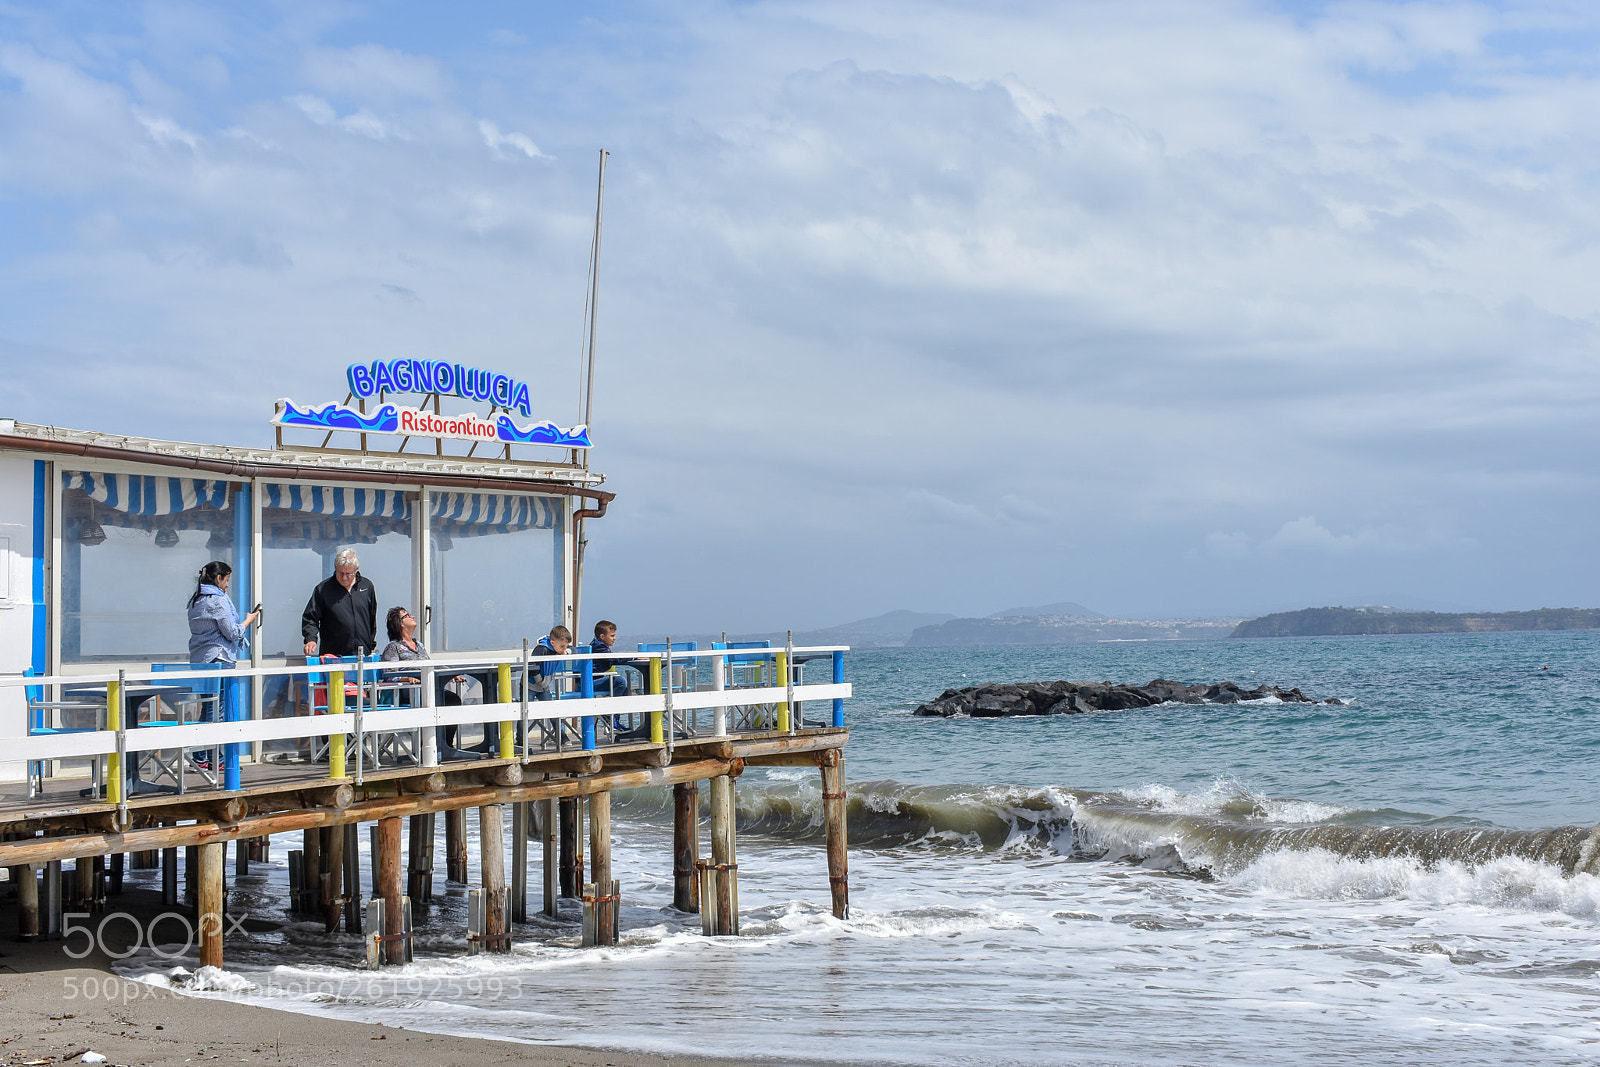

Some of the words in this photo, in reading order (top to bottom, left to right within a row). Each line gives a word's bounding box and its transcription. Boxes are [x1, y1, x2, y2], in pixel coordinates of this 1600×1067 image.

[347, 358, 455, 400] BAGNO
[455, 364, 532, 418] LUCIA
[401, 411, 496, 438] Ristorantino
